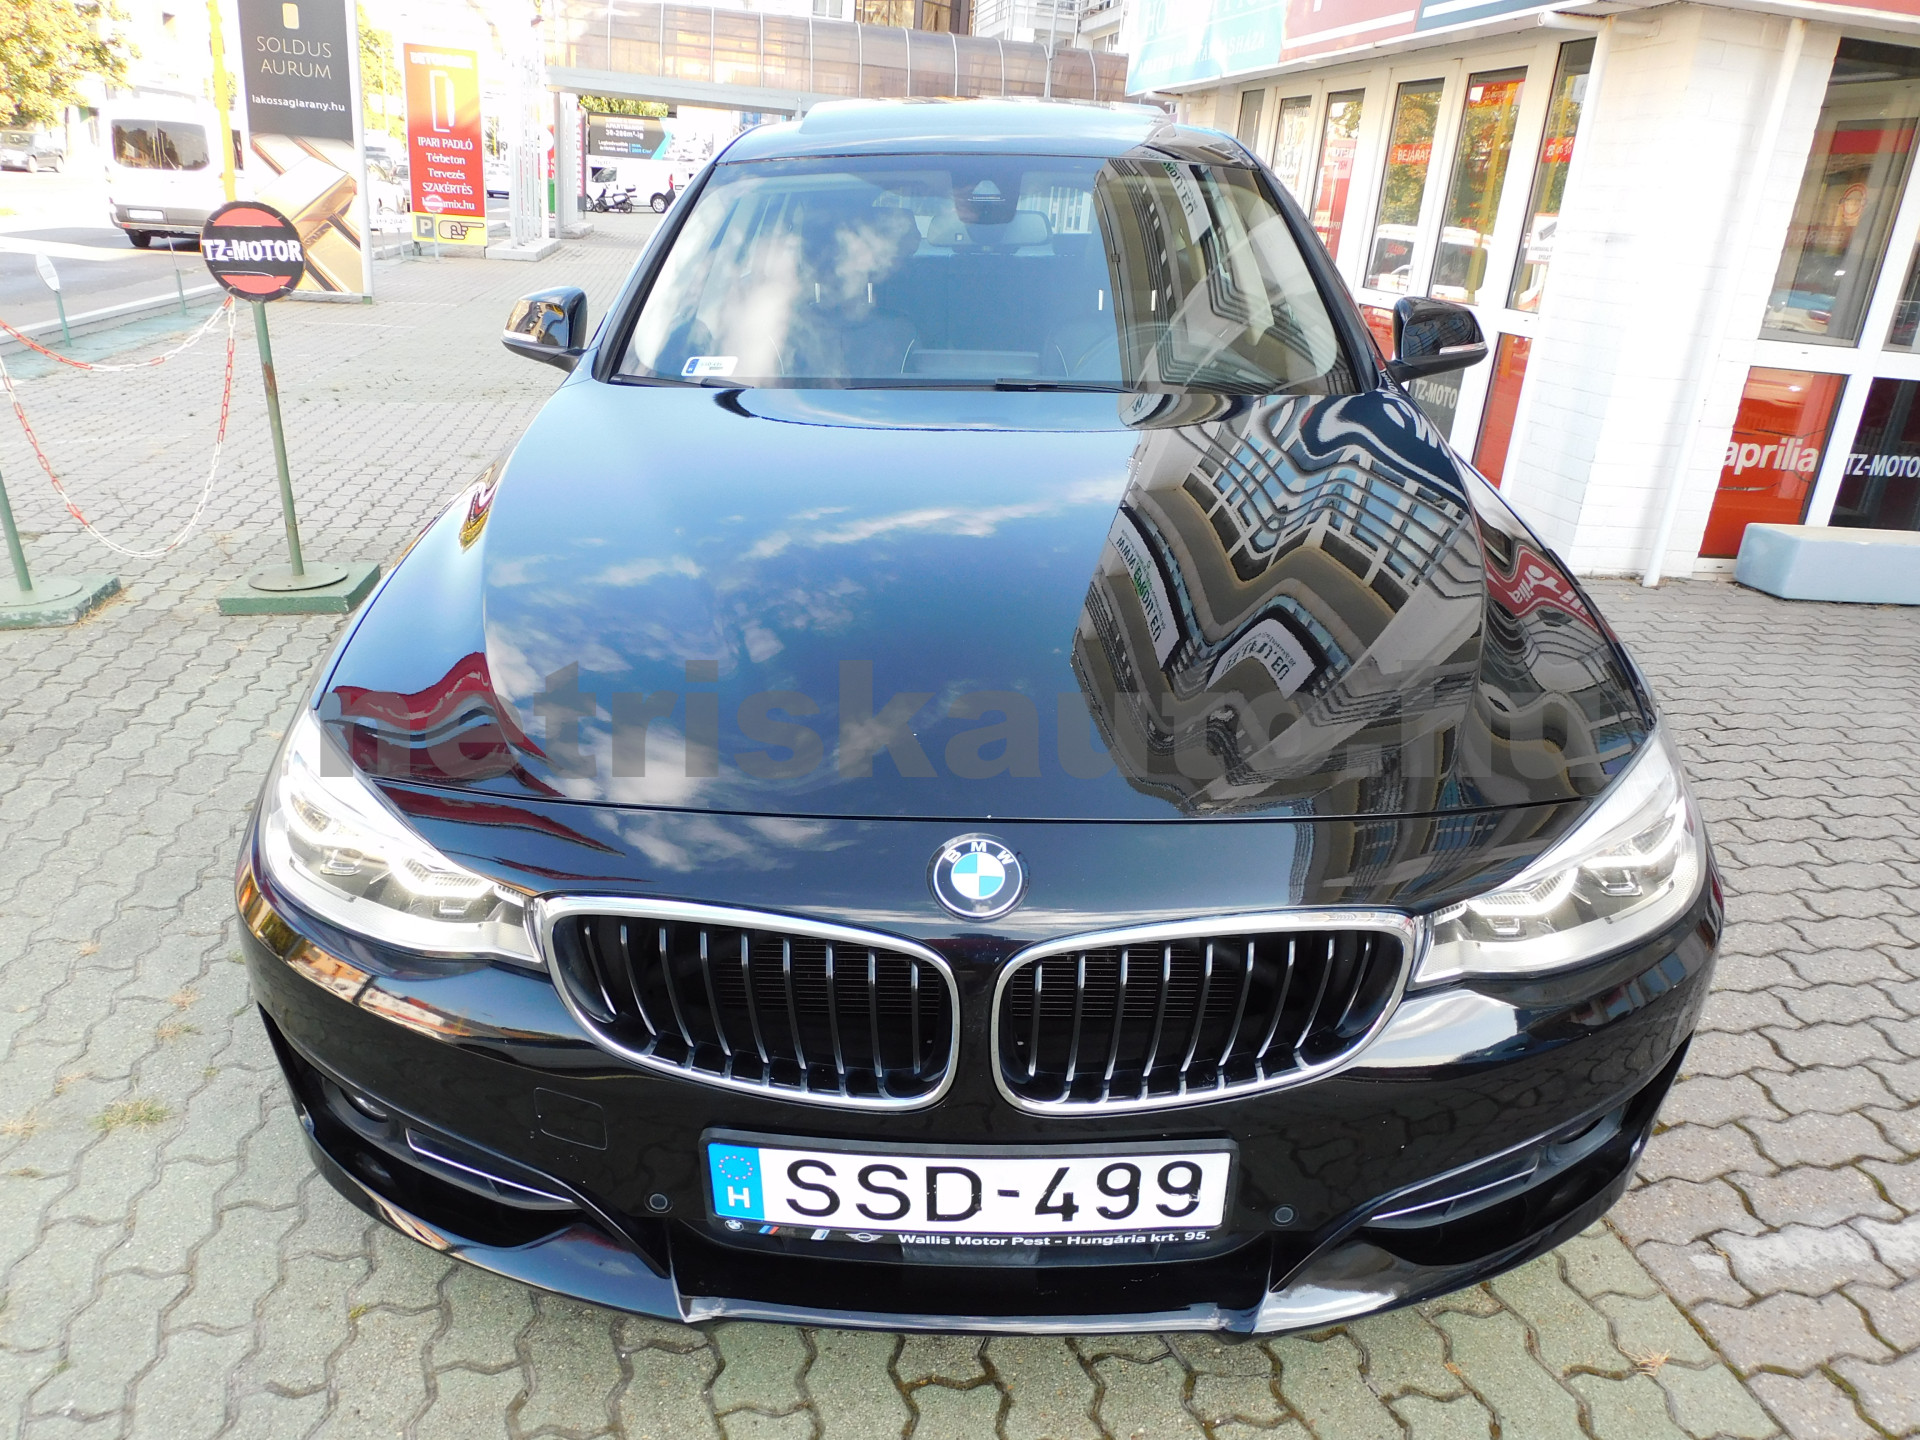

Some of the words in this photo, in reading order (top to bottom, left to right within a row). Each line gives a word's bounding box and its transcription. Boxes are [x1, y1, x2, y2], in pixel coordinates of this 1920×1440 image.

[256, 35, 332, 59] SOLDUS
[260, 58, 332, 80] AURUM
[417, 136, 441, 148] IPARI
[442, 138, 474, 151] PADLÓ
[425, 152, 466, 165] Térbeton
[427, 167, 466, 180] Tervezés
[422, 181, 474, 195] SZAKÉRTÉS
[201, 239, 304, 262] TZ-MOTOR
[1723, 437, 1819, 475] aprilia
[1844, 453, 1920, 478] TZ-MOTO
[945, 841, 1015, 865] BMW
[727, 1186, 750, 1208] H
[786, 1159, 1203, 1222] SSD-499
[898, 1234, 951, 1245] Wallis
[955, 1236, 1008, 1246] Motor
[1011, 1237, 1051, 1246] Pest
[1067, 1235, 1146, 1246] Hungária
[1150, 1233, 1179, 1243] krt.
[1184, 1231, 1211, 1241] 95.
